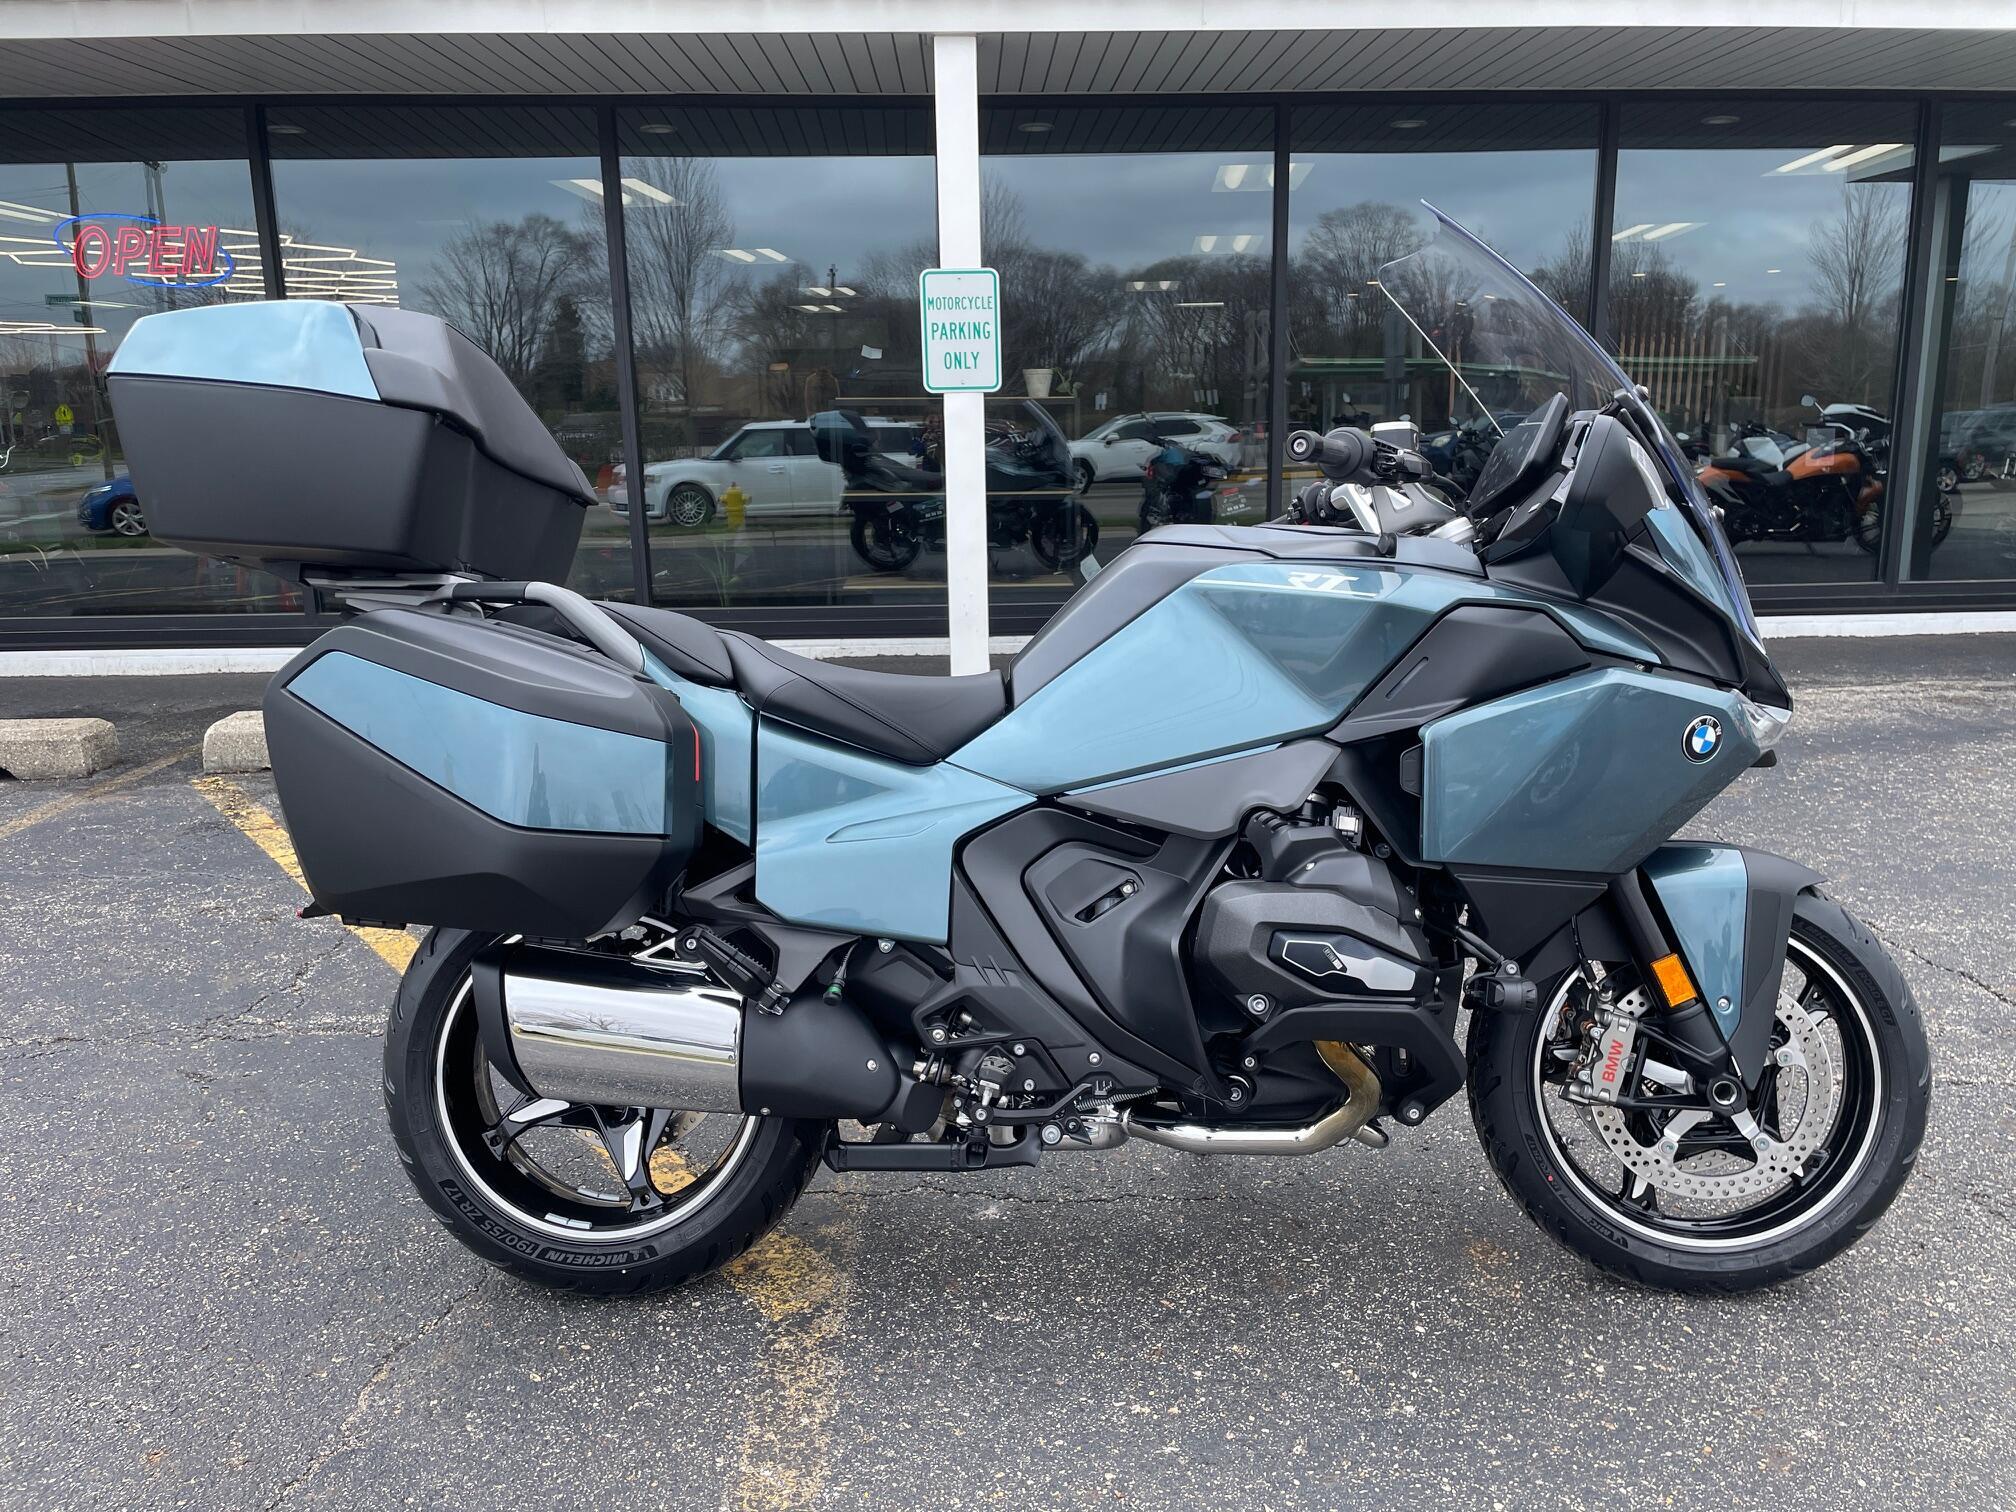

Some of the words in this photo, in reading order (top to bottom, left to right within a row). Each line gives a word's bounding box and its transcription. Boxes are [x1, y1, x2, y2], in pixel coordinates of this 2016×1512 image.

[74, 225, 217, 279] OPEN
[927, 296, 993, 310] MOTORCYCLE
[931, 322, 991, 340] PARKING
[944, 352, 980, 369] ONLY
[1288, 571, 1360, 592] RT
[1602, 1039, 1624, 1082] BMW
[443, 1186, 462, 1202] 17
[459, 1201, 484, 1220] ZR
[480, 1219, 536, 1255] 190/55
[545, 1249, 628, 1266] MICHELIN
